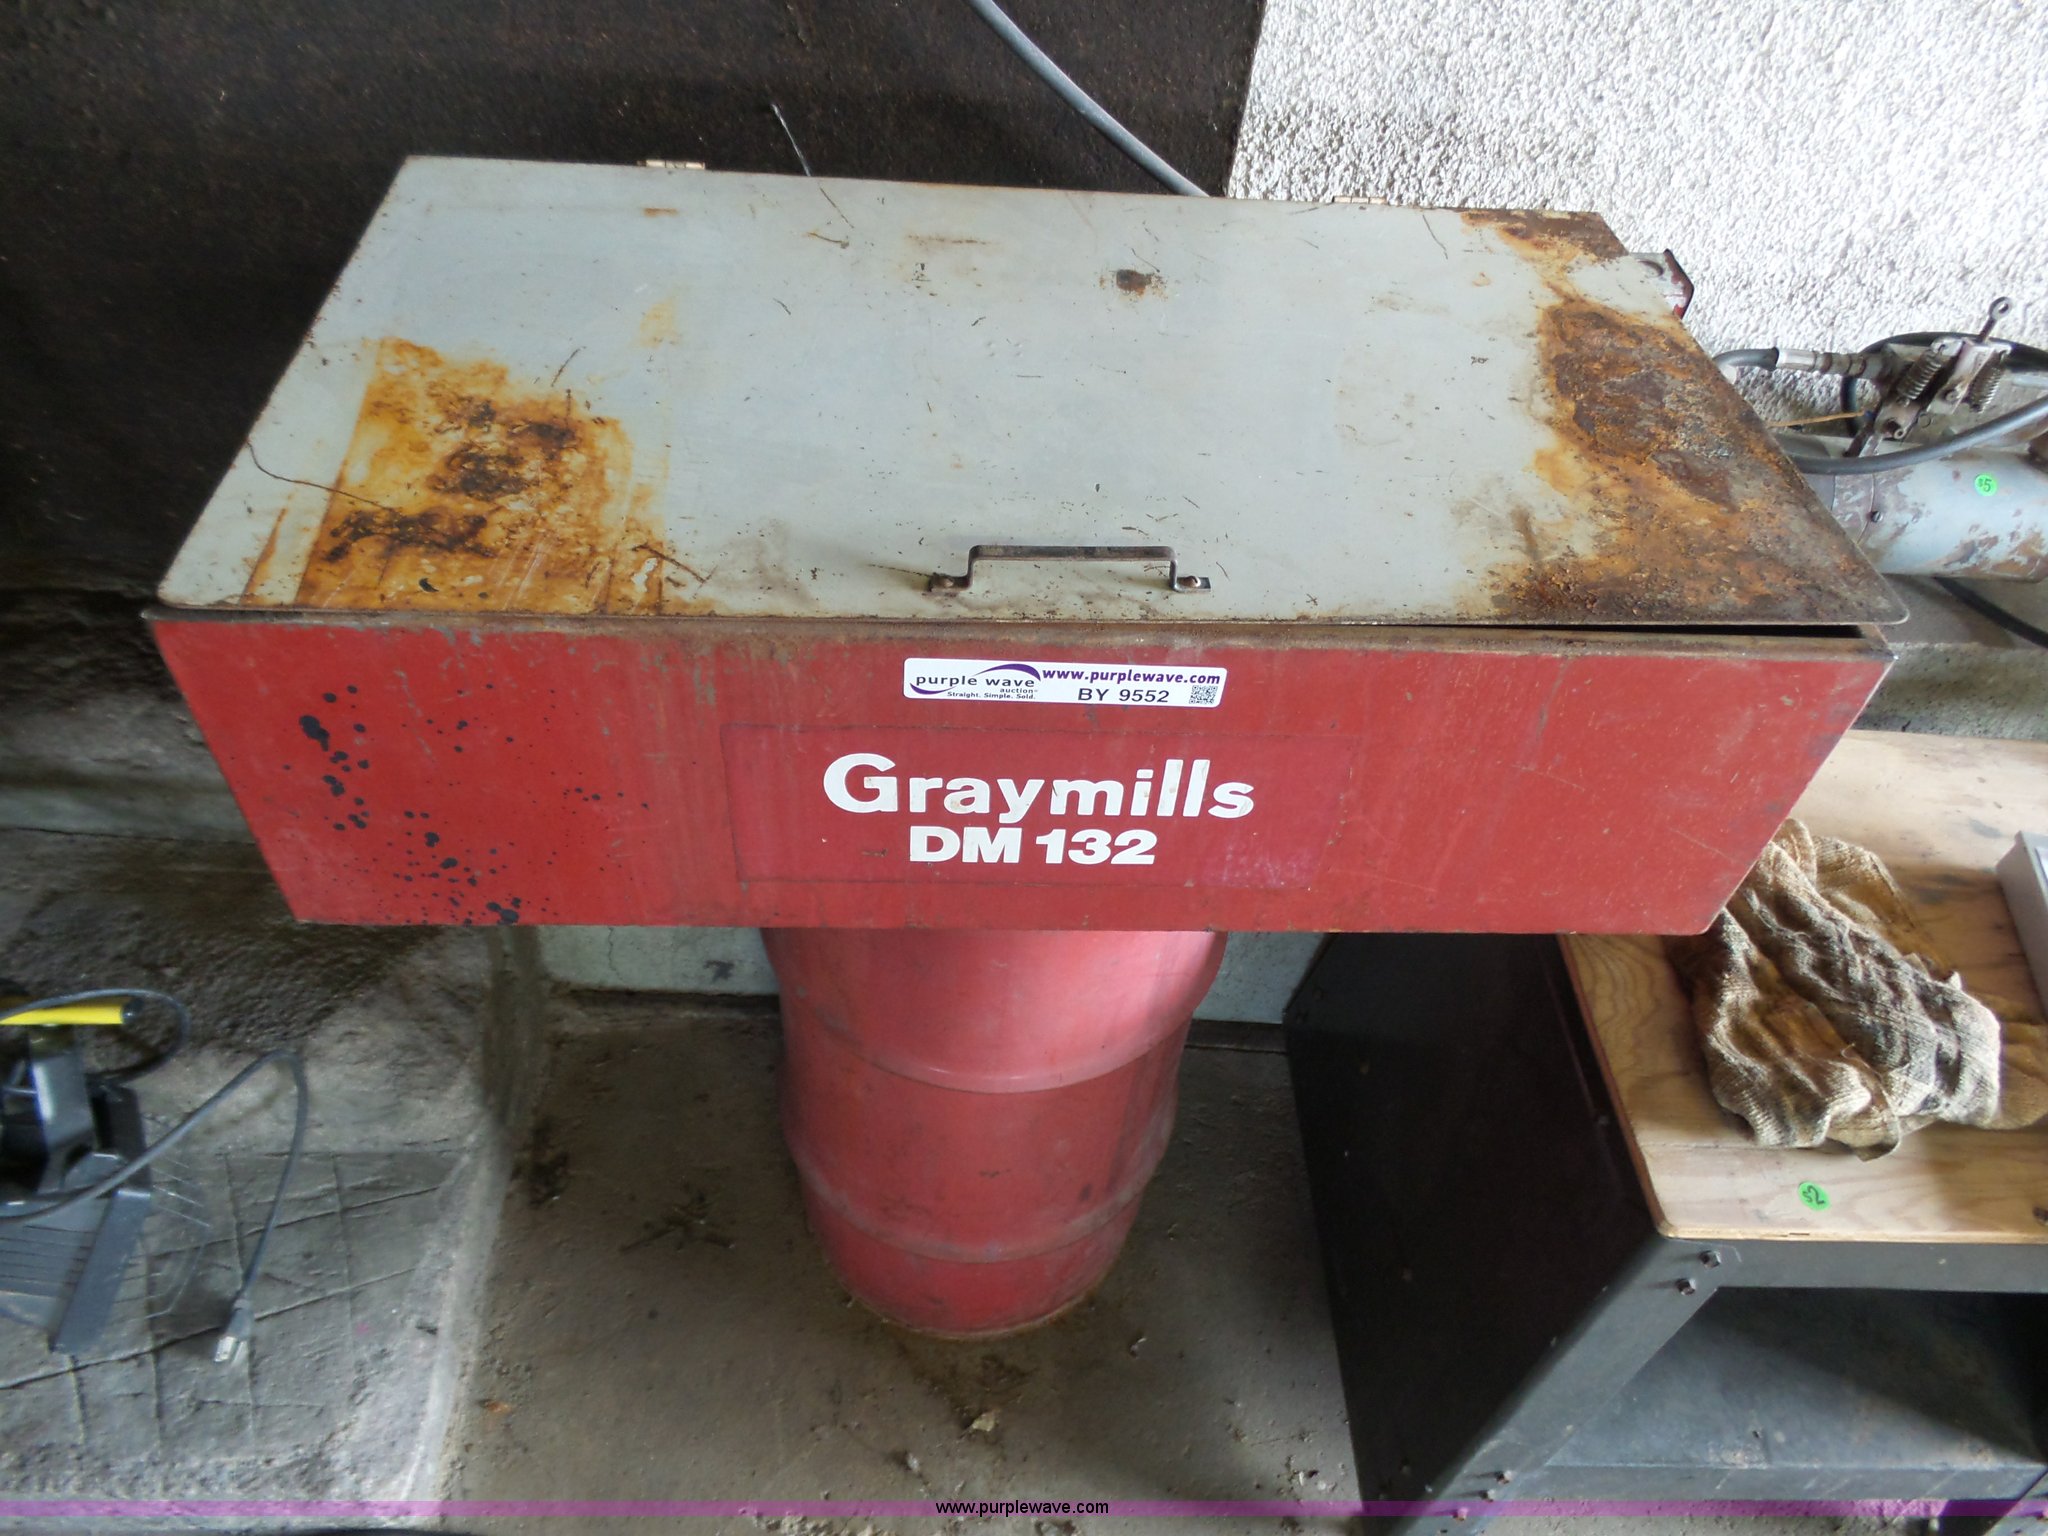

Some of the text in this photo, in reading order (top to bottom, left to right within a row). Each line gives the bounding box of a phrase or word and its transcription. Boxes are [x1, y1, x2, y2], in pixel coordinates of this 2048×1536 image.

[916, 675, 1035, 688] purple wave
[1042, 669, 1221, 685] www.purplewave.com
[947, 691, 982, 699] Straight.
[1077, 687, 1170, 703] BY 9552
[823, 753, 1254, 823] Graymills
[909, 826, 1158, 864] DM 132
